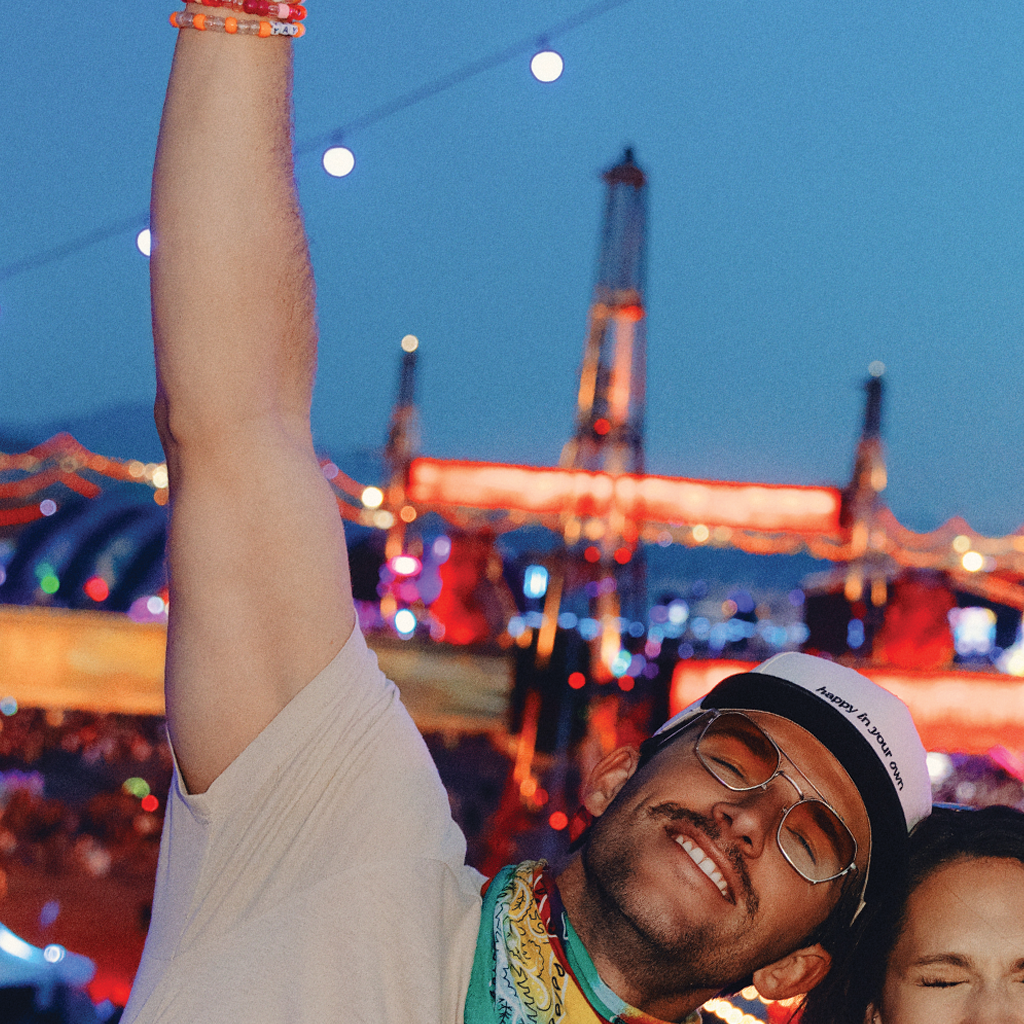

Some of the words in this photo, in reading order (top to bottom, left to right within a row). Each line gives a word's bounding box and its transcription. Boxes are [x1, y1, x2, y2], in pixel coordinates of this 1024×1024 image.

[816, 686, 858, 714] happy
[857, 712, 871, 727] in
[868, 726, 893, 758] your
[889, 761, 904, 791] own
